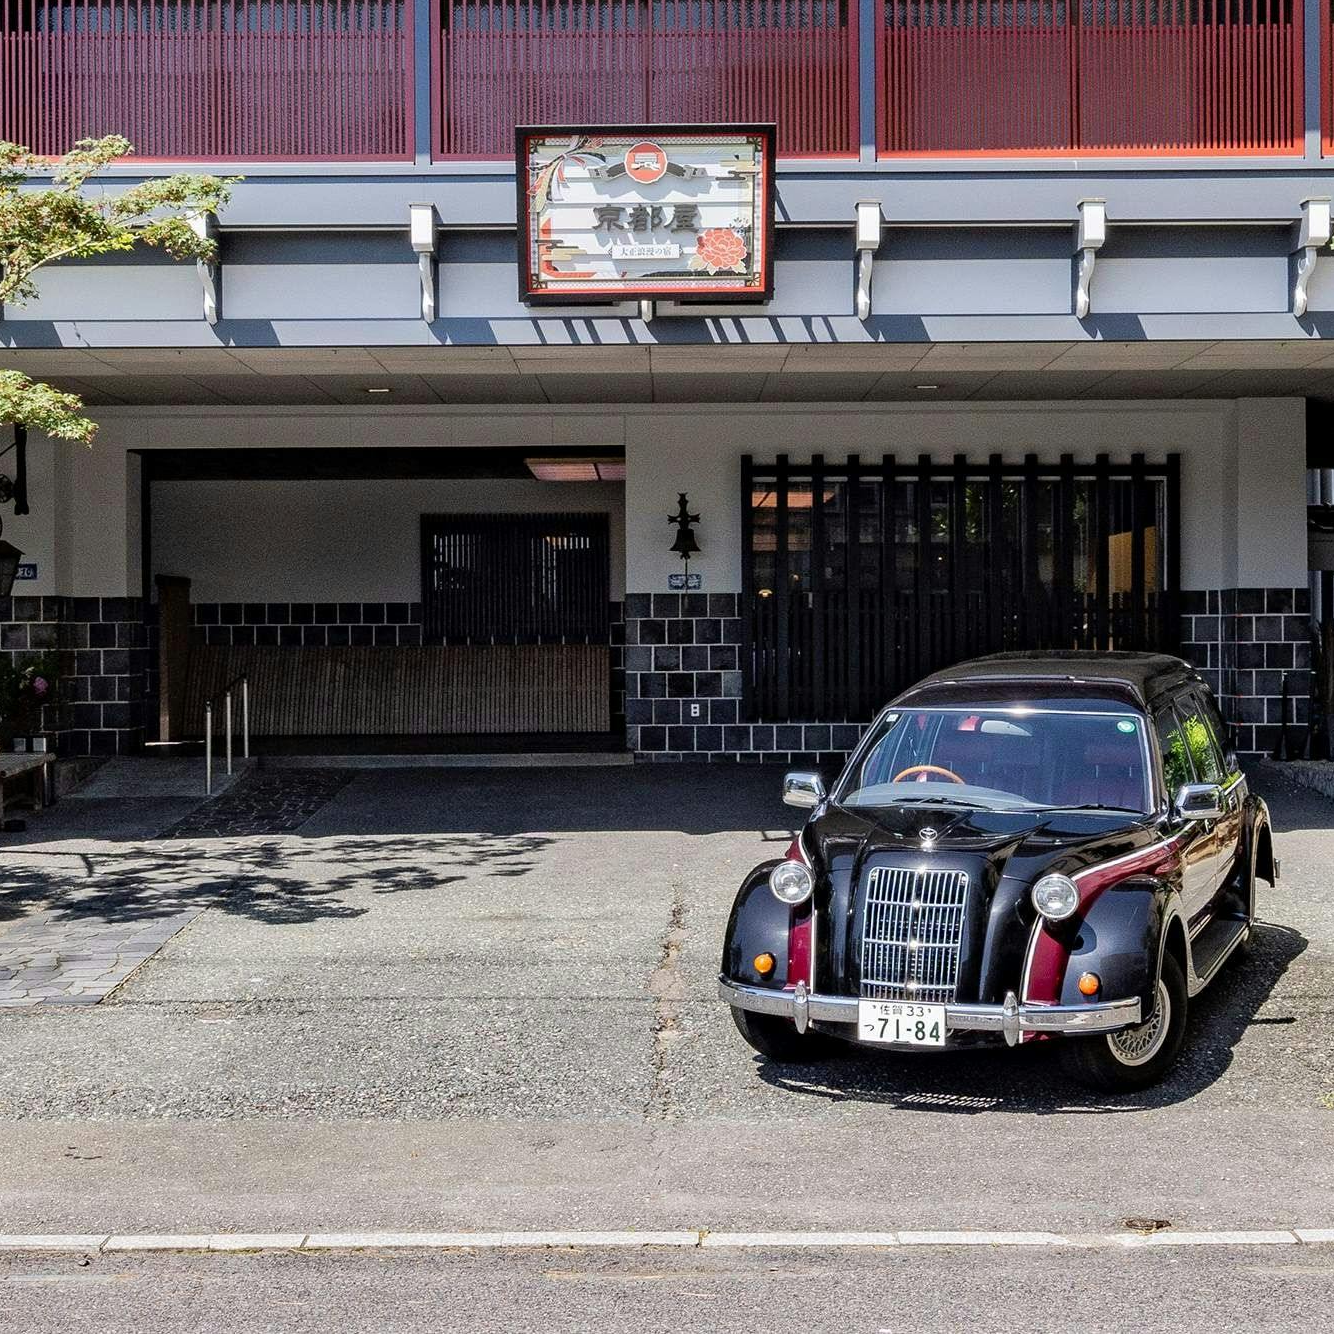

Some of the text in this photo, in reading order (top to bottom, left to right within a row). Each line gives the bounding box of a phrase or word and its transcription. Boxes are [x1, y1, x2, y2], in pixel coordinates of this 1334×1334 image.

[592, 203, 700, 233] 京都屋
[878, 1018, 941, 1042] 71-84
